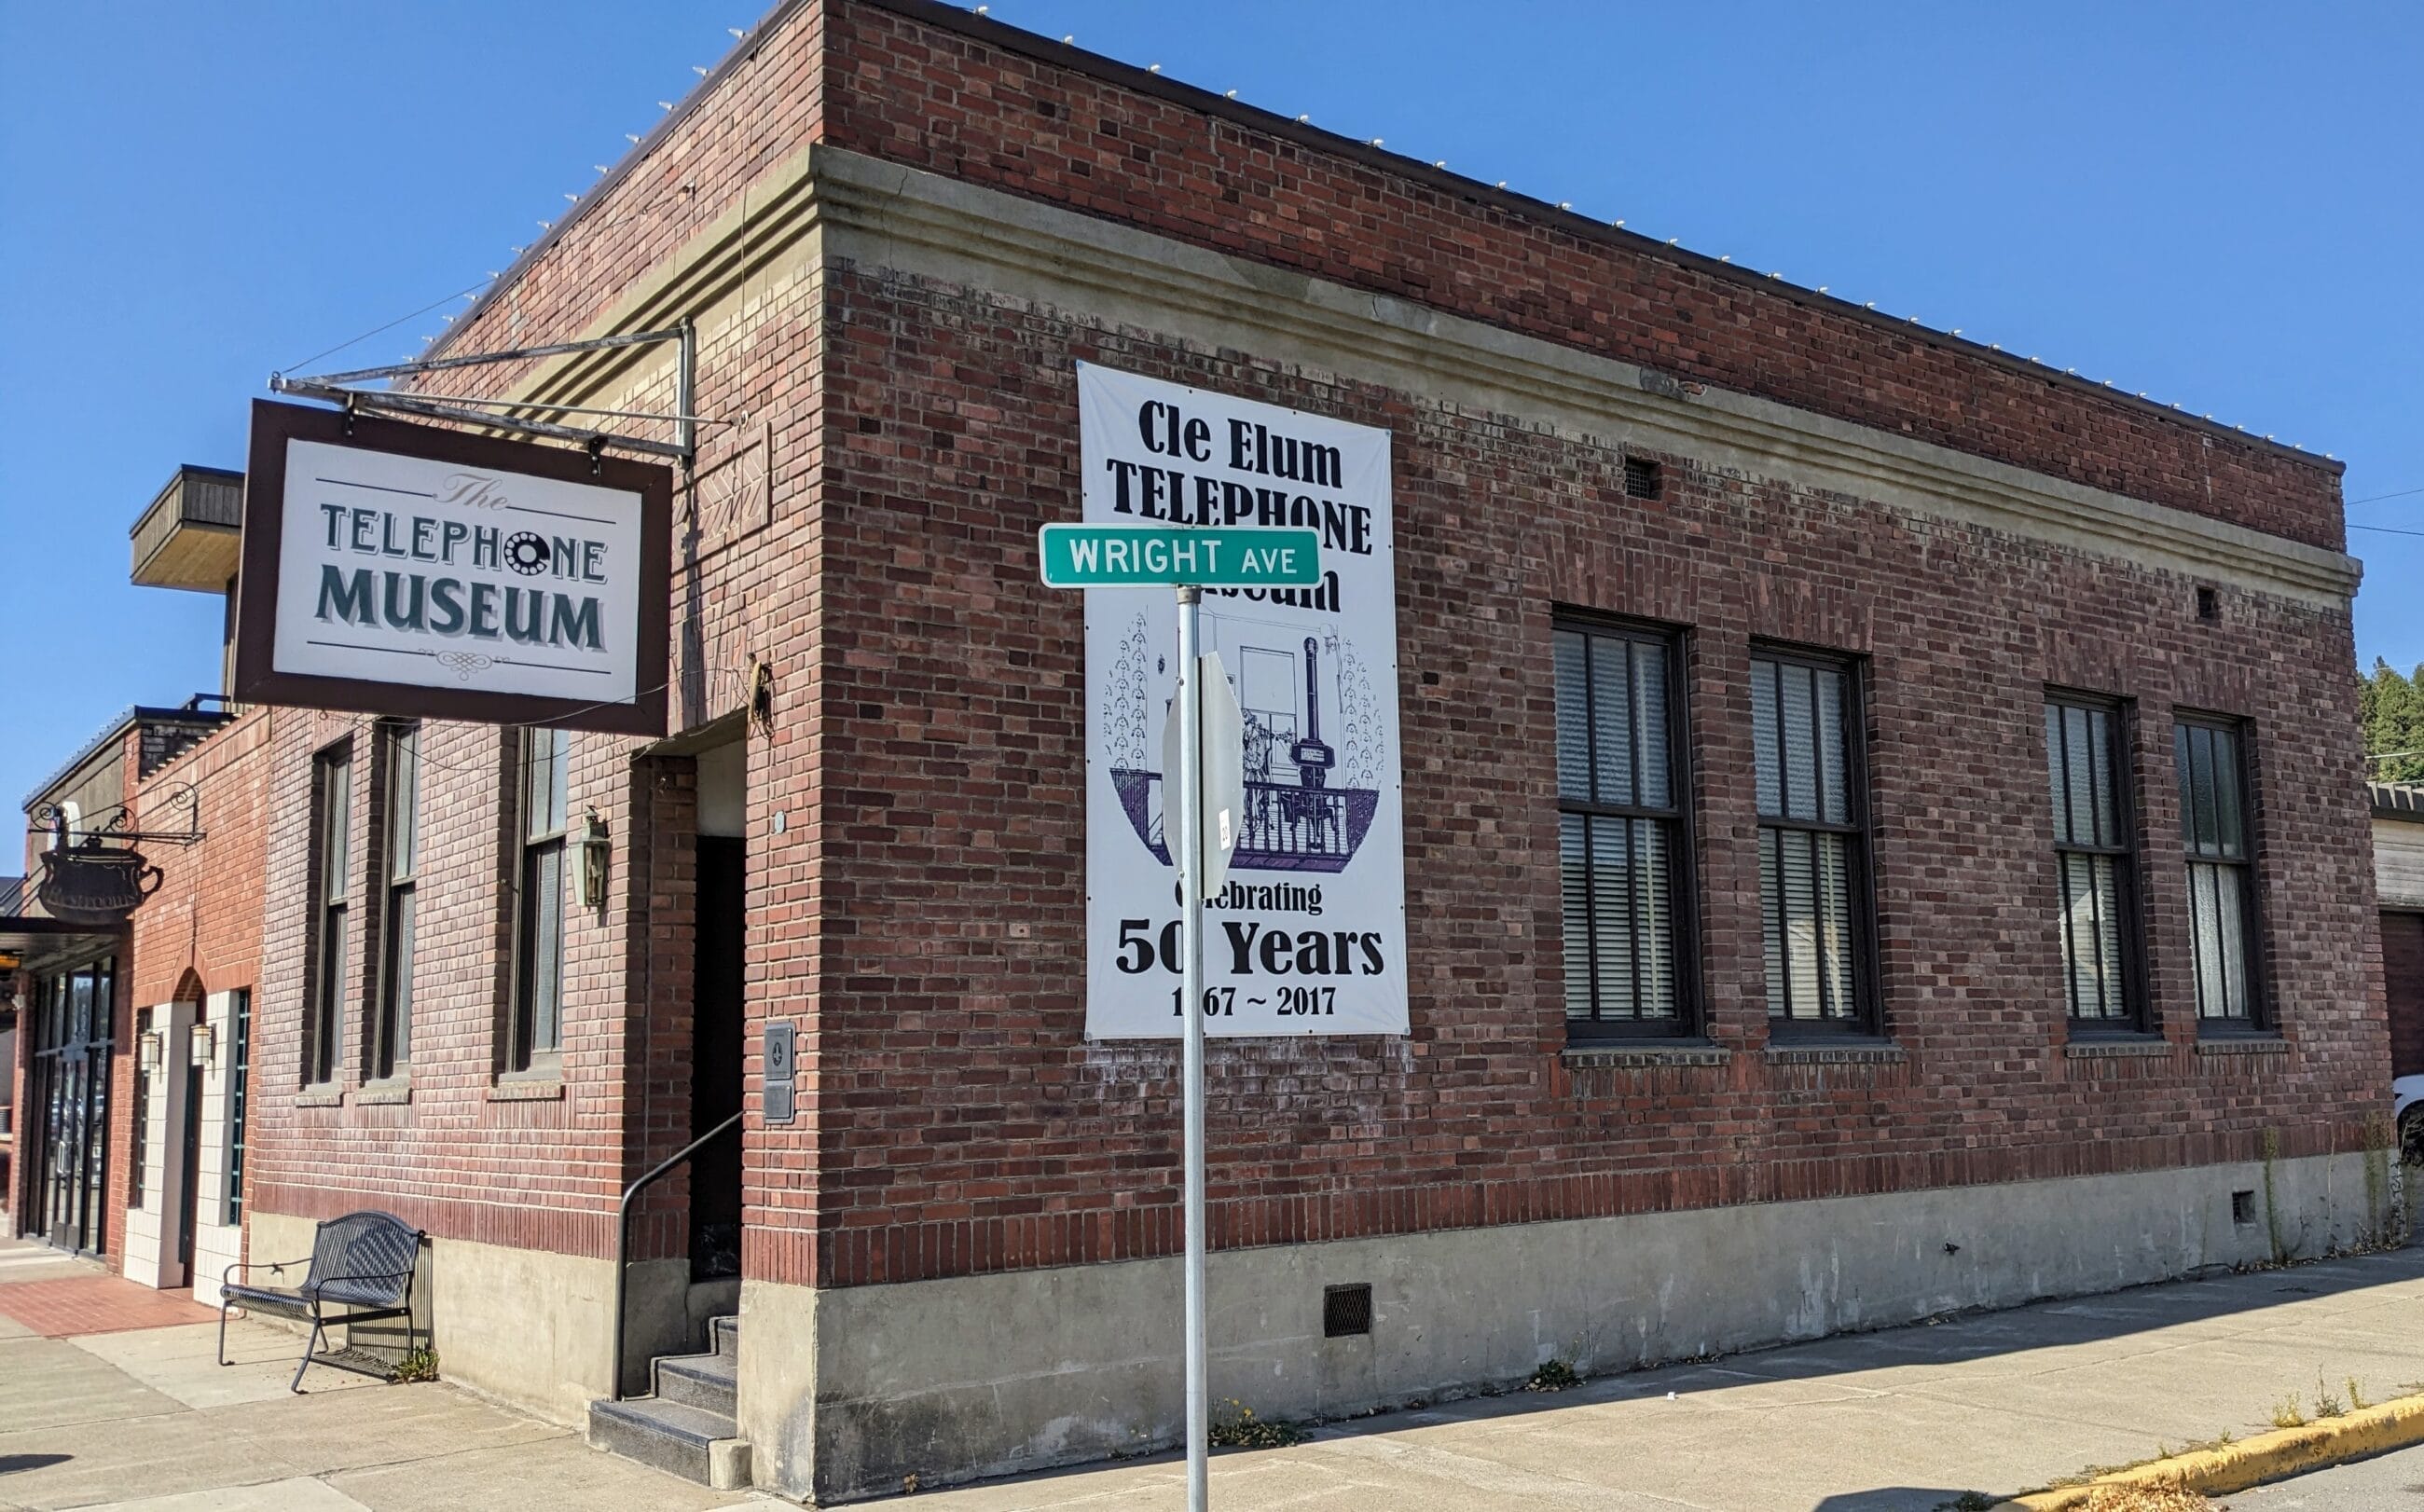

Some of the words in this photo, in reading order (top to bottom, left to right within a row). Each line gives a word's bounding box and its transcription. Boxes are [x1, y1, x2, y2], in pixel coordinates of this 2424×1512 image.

[1138, 400, 1211, 463] Cle
[1227, 418, 1343, 489] Elum
[433, 473, 510, 511] The
[1107, 459, 1372, 557] TELEPHONE
[320, 503, 608, 585] TELEPHONE
[1069, 539, 1222, 574] WRIGHT
[1241, 548, 1298, 575] AVE
[314, 564, 608, 653] MUSEUM
[1174, 879, 1323, 916] ebrating
[1221, 922, 1385, 977] Years
[1172, 986, 1237, 1017] 167
[1277, 986, 1337, 1016] 2017
